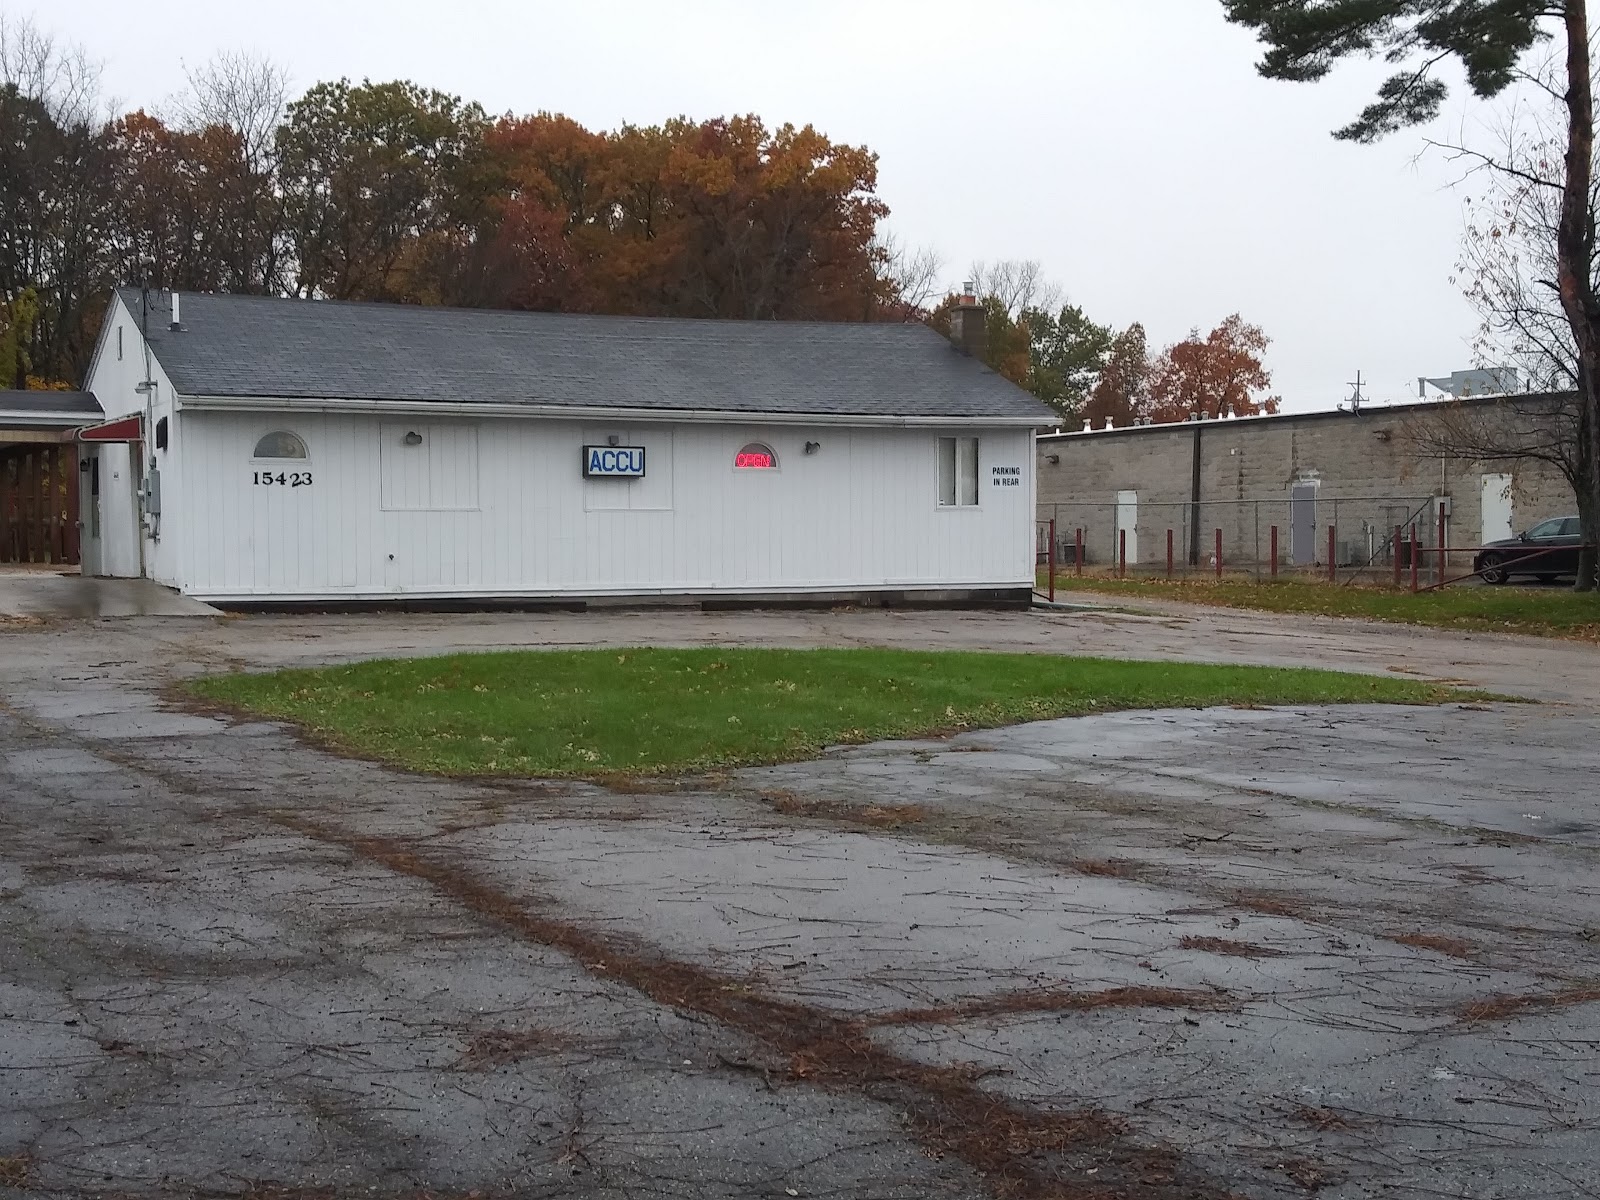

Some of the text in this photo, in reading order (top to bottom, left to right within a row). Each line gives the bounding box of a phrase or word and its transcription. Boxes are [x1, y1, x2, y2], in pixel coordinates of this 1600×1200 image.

[589, 450, 643, 473] ACCU
[737, 453, 771, 468] OPEN
[992, 466, 1021, 476] PARKING
[253, 471, 313, 488] 15423
[993, 477, 1020, 487] IN REAR
